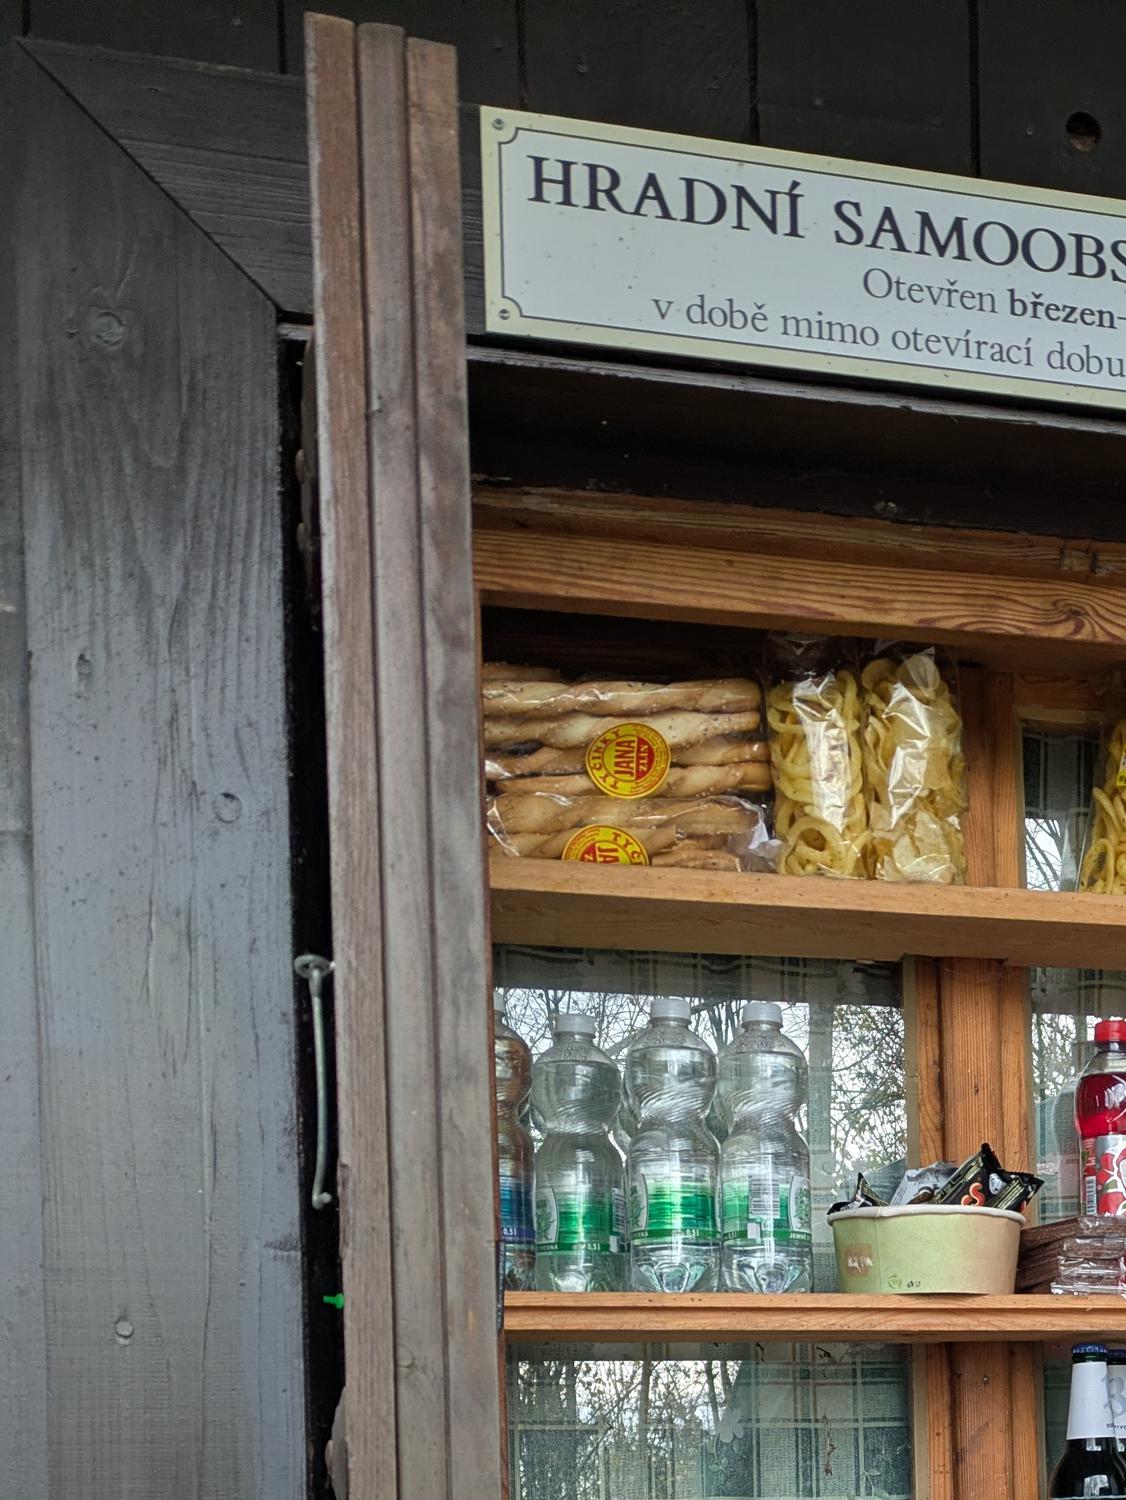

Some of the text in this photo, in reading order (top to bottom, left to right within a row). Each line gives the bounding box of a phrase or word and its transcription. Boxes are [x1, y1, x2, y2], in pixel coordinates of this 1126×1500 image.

[527, 154, 806, 239] HRADNÍ
[863, 266, 998, 313] Otevřen
[653, 299, 674, 321] v
[686, 295, 769, 333] době
[780, 311, 880, 347] mimo
[891, 326, 1034, 367] otevírací
[1046, 340, 1126, 379] dobu
[614, 739, 636, 778] JANA
[612, 831, 643, 865] TYČI
